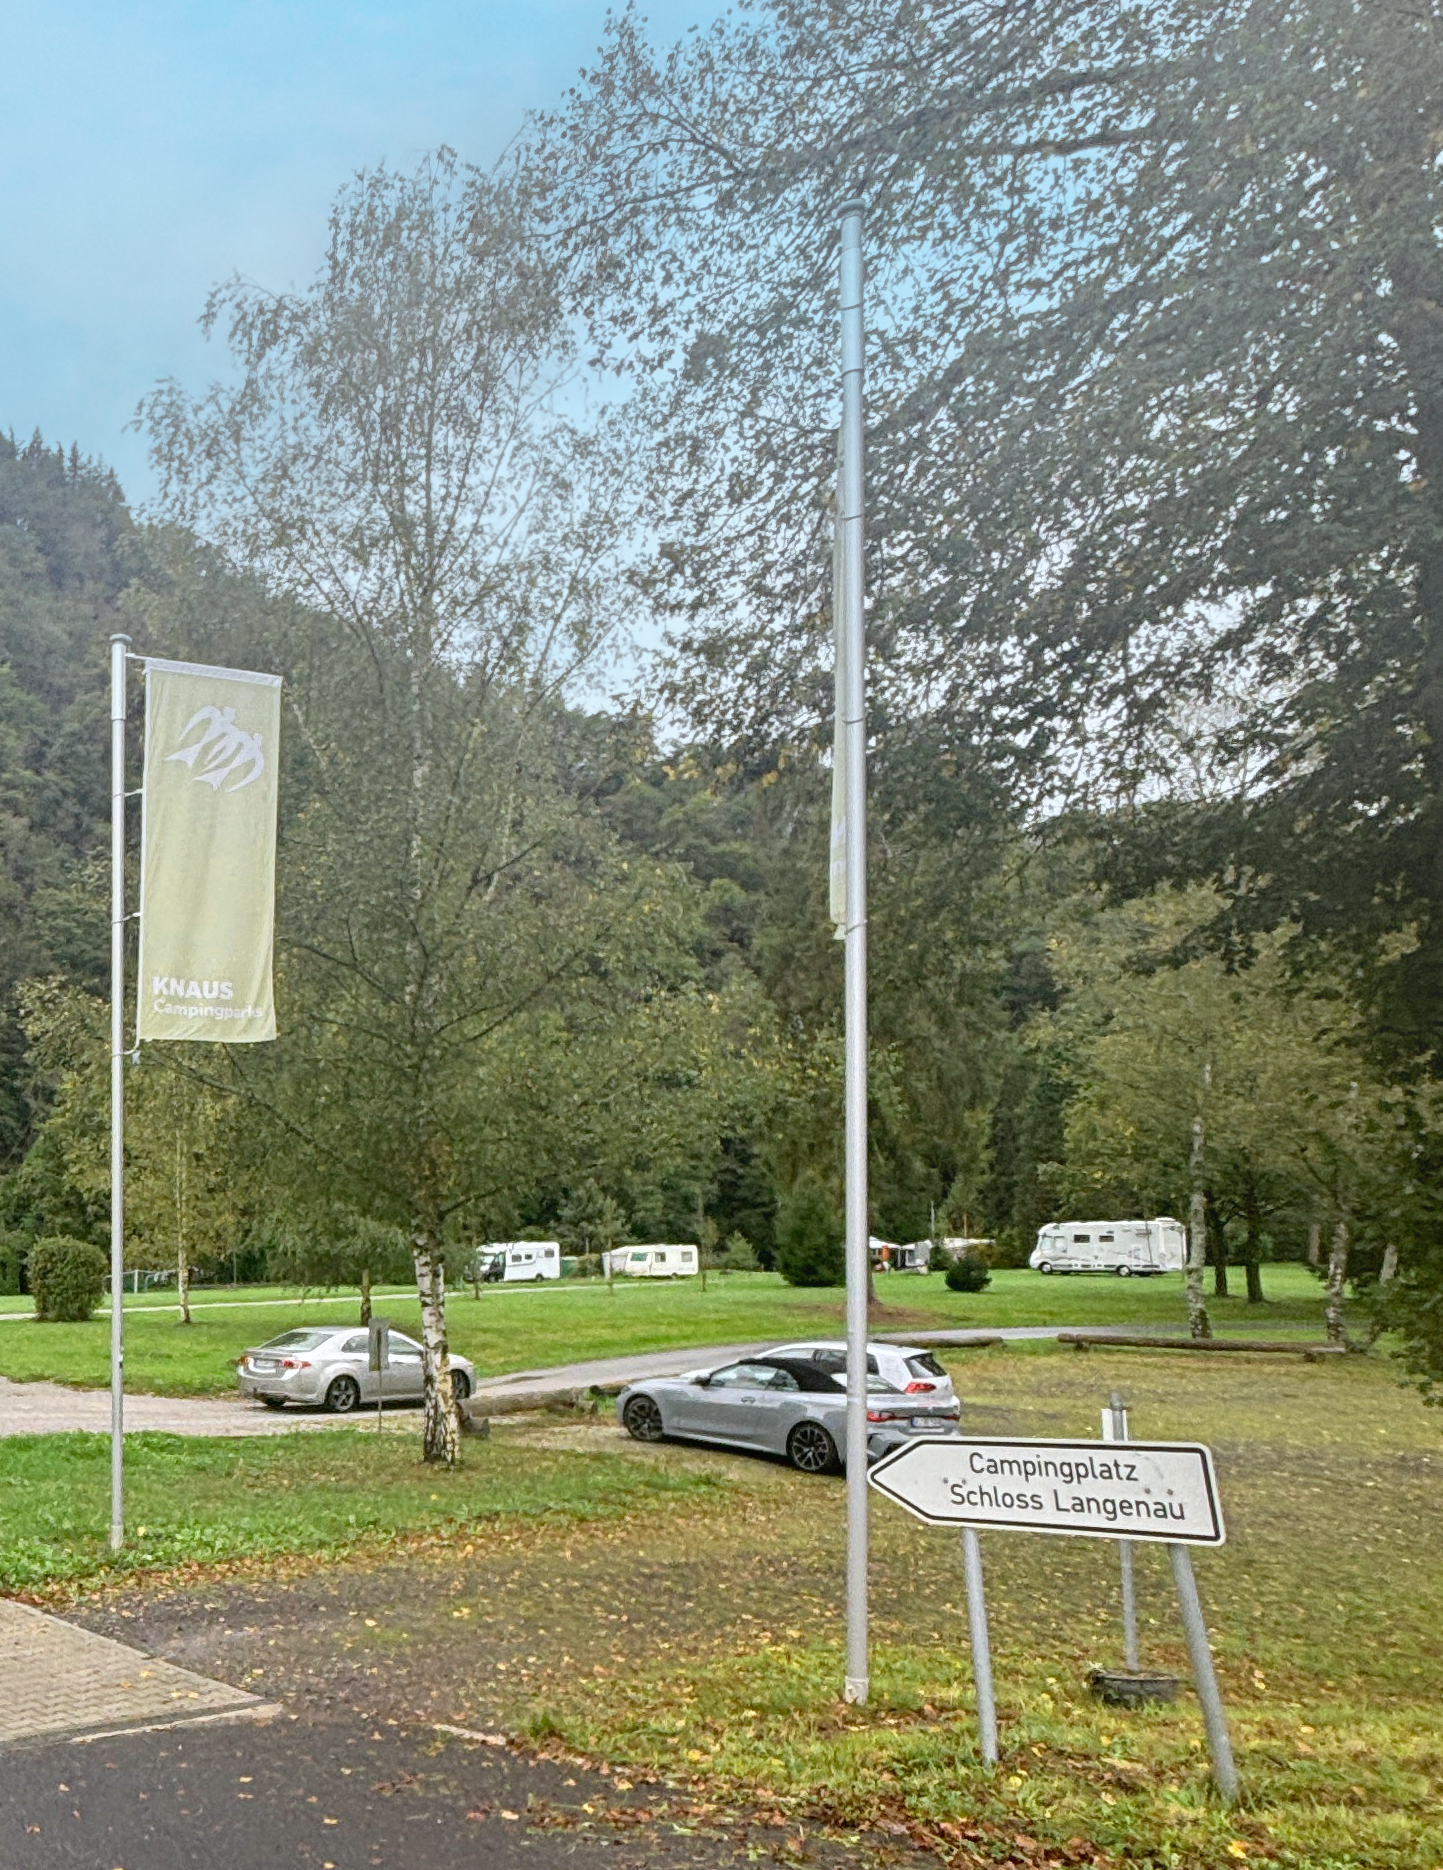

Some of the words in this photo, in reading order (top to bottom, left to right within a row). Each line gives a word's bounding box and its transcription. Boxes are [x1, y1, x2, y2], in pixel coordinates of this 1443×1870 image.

[152, 976, 234, 1000] KNAUS
[968, 1451, 1139, 1485] Campingplatz
[950, 1483, 1044, 1511] Schloss
[1053, 1488, 1186, 1522] Langenau
